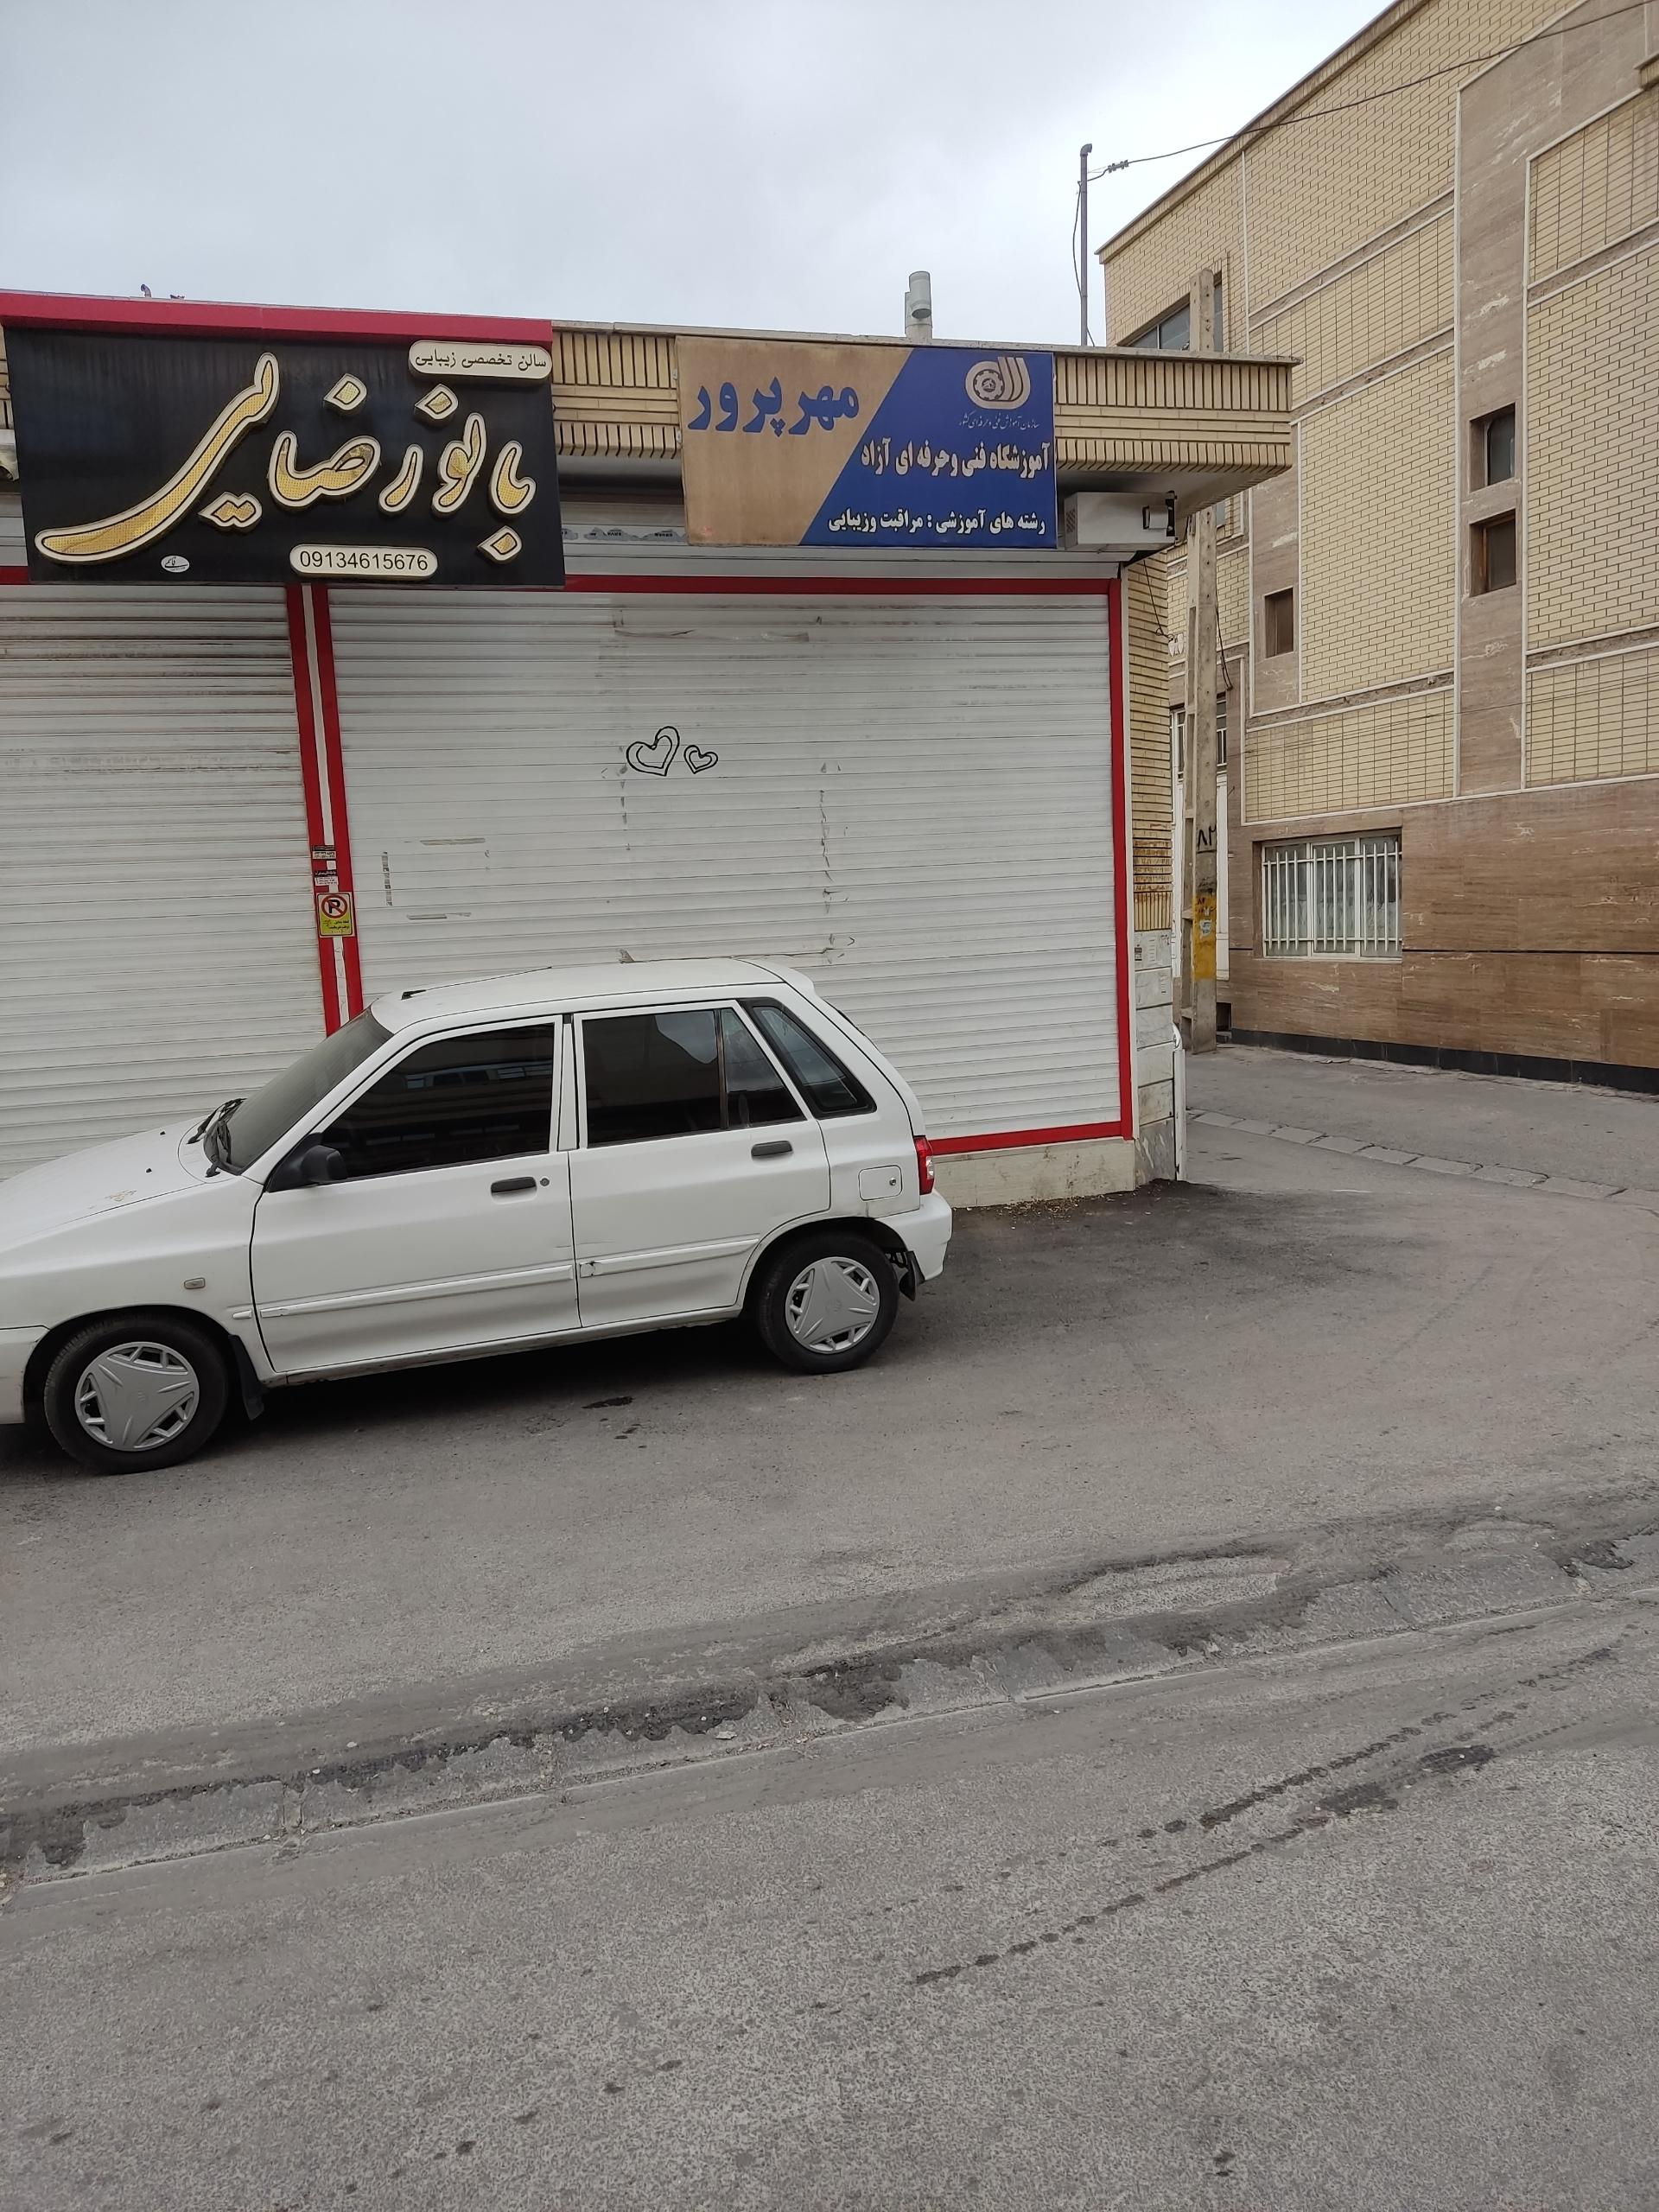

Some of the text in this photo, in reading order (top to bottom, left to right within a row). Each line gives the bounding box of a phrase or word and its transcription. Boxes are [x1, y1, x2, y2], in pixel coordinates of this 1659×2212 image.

[415, 348, 547, 371] سالن تخصصی زیبایی
[687, 375, 860, 438] مهر پرور
[35, 352, 537, 563] بانو رضایی
[861, 437, 892, 475] آزاد
[962, 441, 987, 477] فنی
[989, 442, 1051, 479] آموزشگاه
[880, 508, 925, 533] مراقبت
[988, 512, 1014, 534] های
[1017, 511, 1046, 535] رشته
[300, 550, 429, 571] 09134615676
